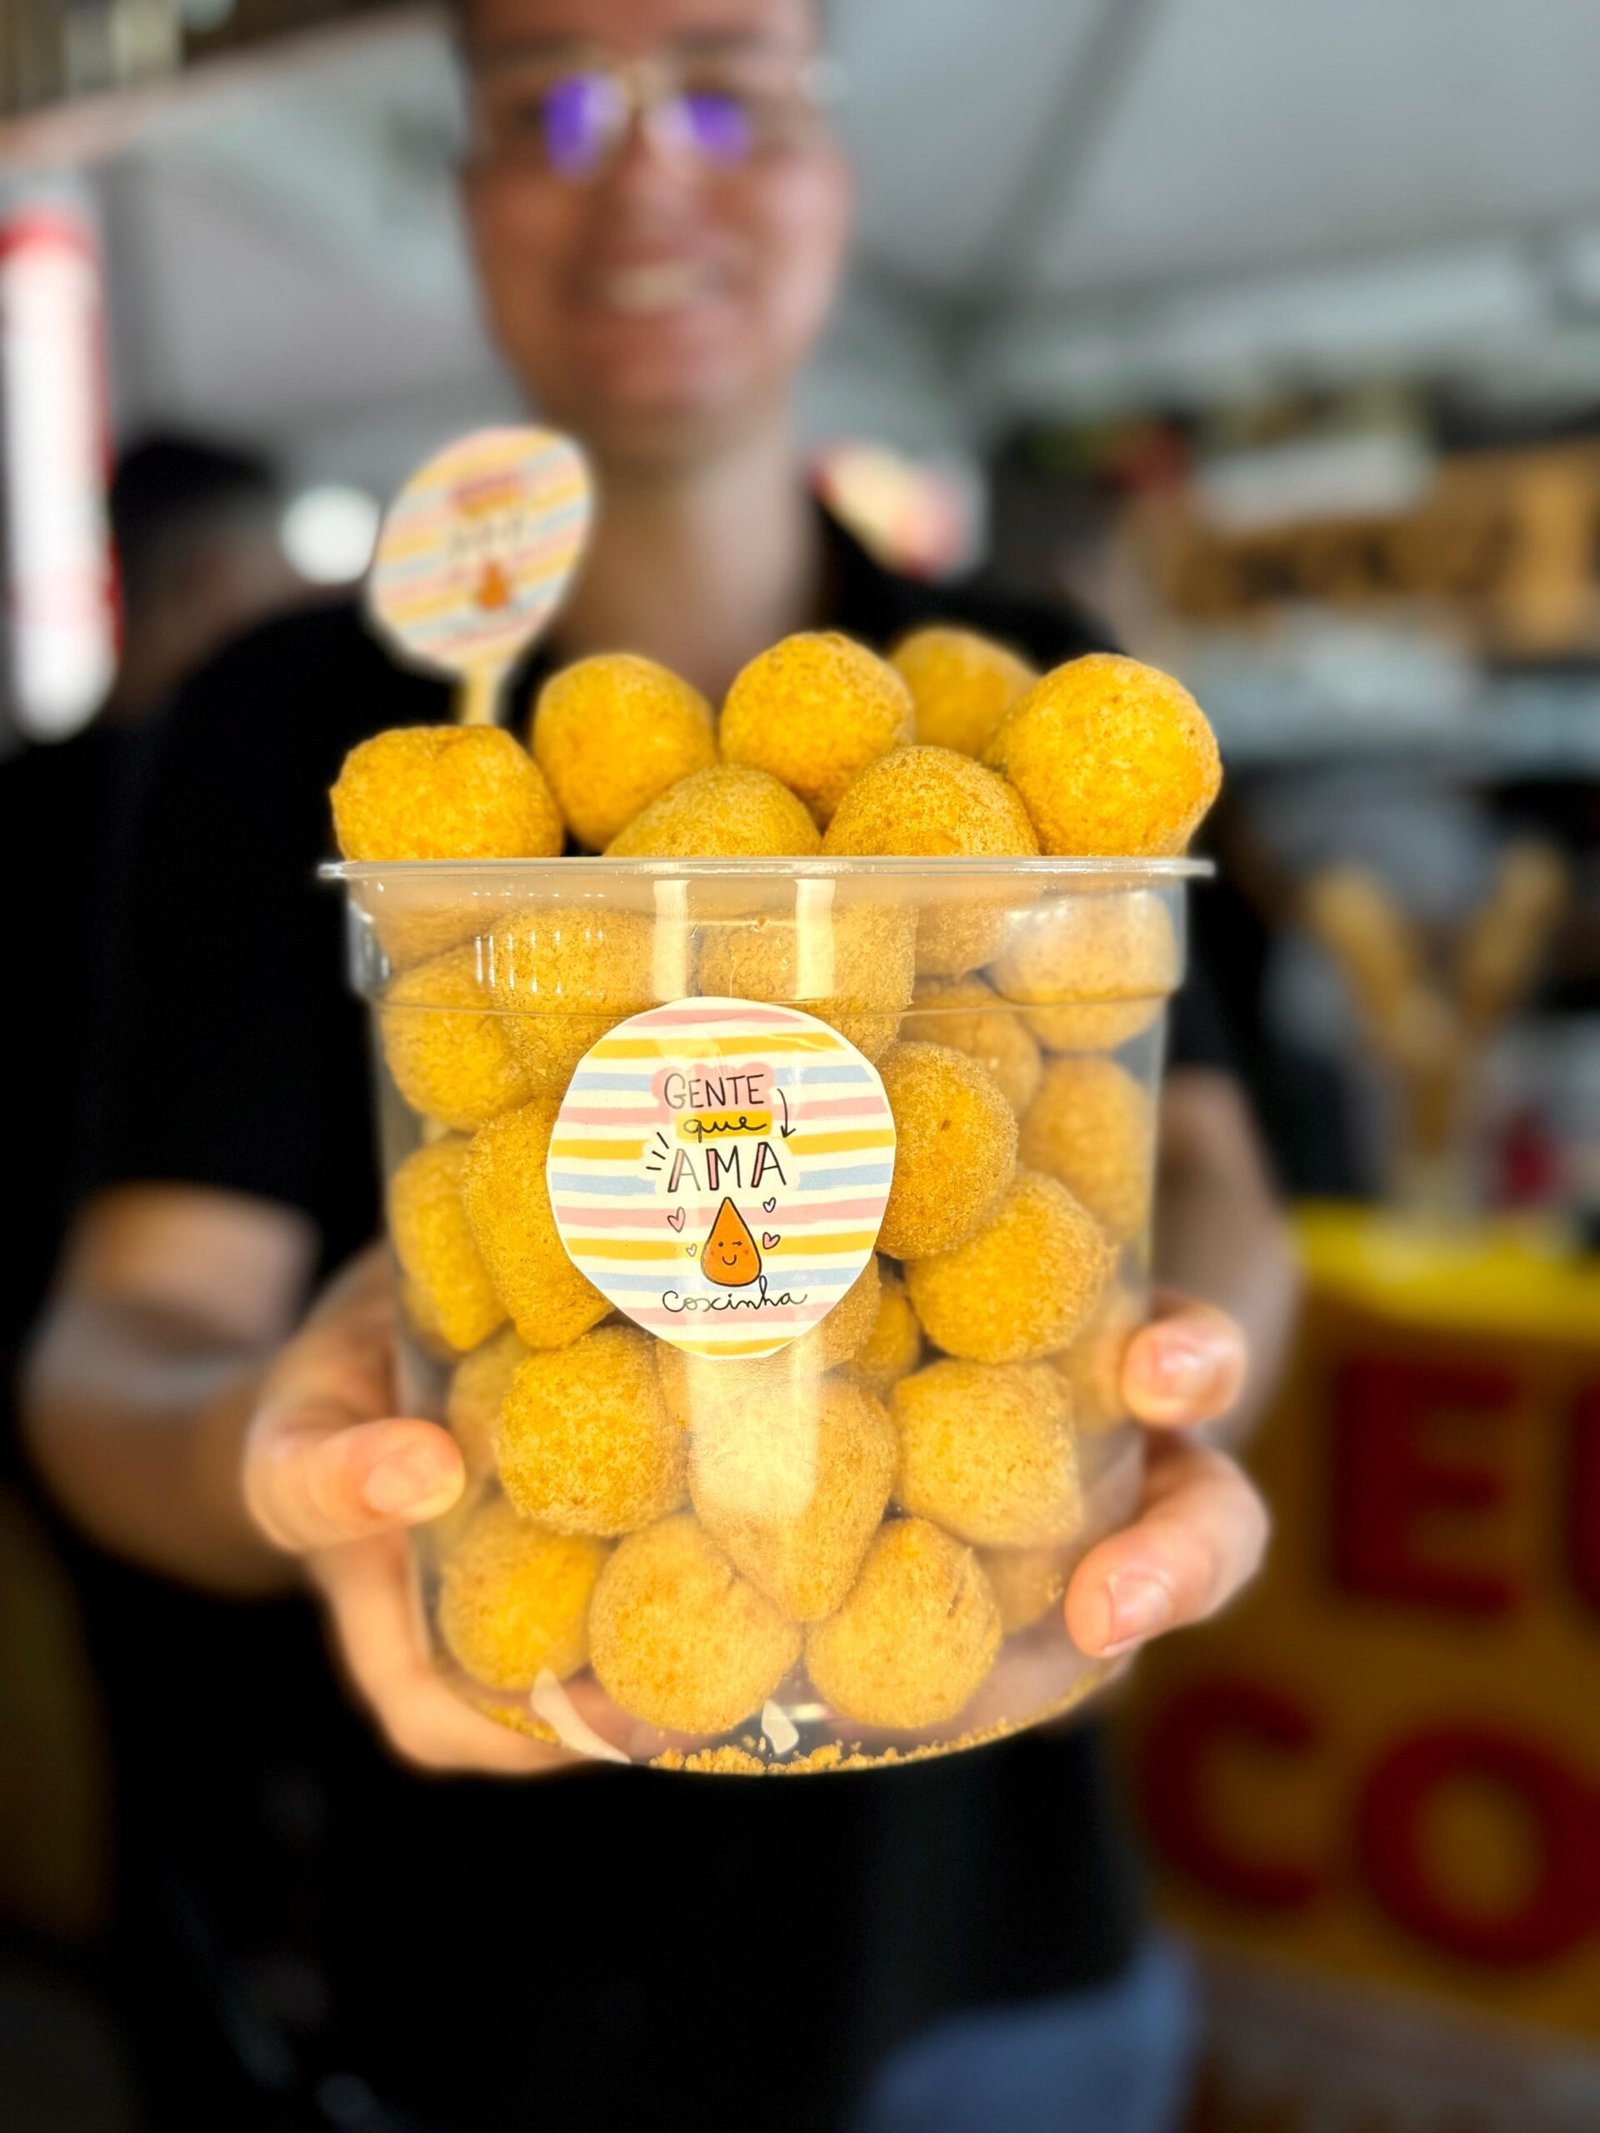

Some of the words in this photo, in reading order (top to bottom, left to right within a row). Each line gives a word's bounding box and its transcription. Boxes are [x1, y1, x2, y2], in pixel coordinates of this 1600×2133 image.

[663, 1072, 765, 1110] GENTE
[683, 1115, 767, 1144] que
[667, 1141, 787, 1193] AMA
[662, 1275, 809, 1313] Coxinha
